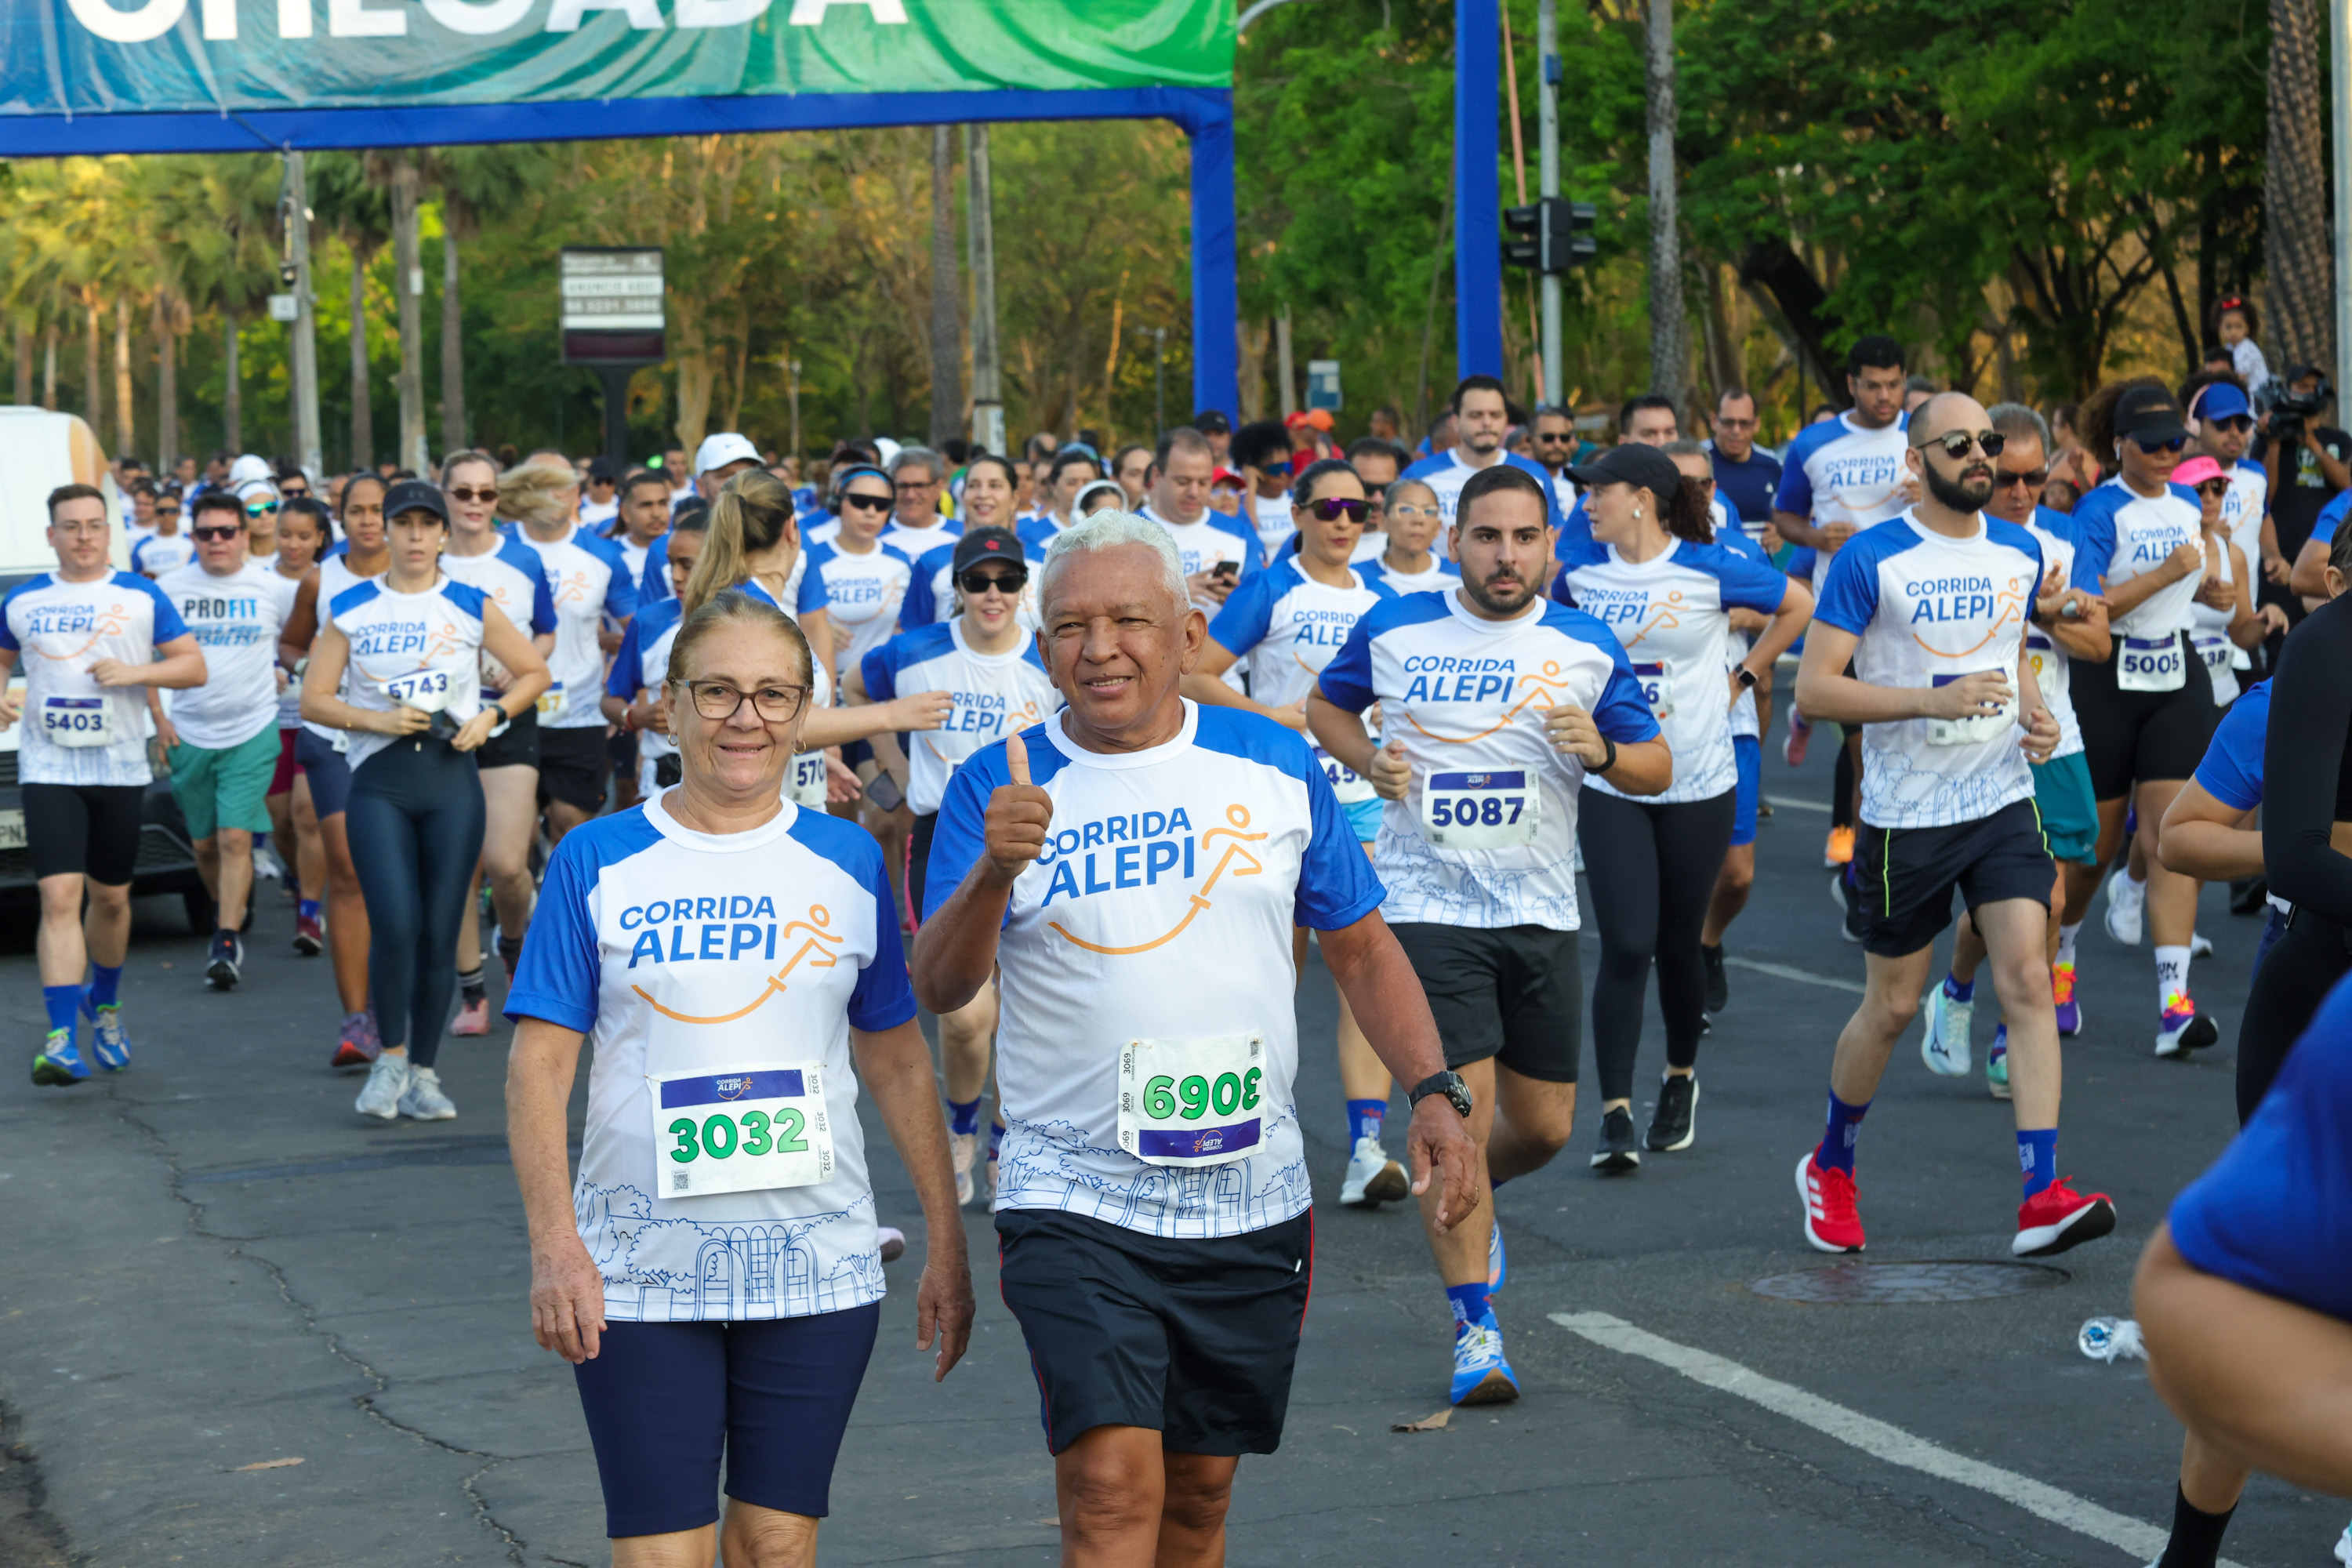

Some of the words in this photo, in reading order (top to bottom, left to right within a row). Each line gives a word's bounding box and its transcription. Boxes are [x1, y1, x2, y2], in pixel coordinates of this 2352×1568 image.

[1825, 455, 1896, 473] CORRIDA
[1829, 468, 1896, 489] ALEPI
[2131, 525, 2186, 542] CORRIDA
[830, 589, 882, 603] ALEPI
[1906, 577, 1992, 597] CORRIDA
[26, 604, 95, 619] CORRIDA
[183, 599, 257, 618] PROFIT
[1911, 595, 1994, 625] ALEPI
[28, 616, 95, 637] ALEPI
[358, 622, 426, 638] CORRIDA
[355, 635, 426, 655] ALEPI
[1403, 655, 1515, 673] CORRIDA
[2125, 653, 2180, 674] 5005
[389, 673, 448, 700] 5743
[1403, 675, 1515, 703] ALEPI
[951, 691, 1007, 711] RRIDA
[45, 713, 103, 731] 5403
[943, 710, 1004, 736] LEPI
[1432, 797, 1525, 827] 5087
[1035, 807, 1192, 866] CORRIDA
[1041, 835, 1196, 907] ALEPI
[619, 896, 777, 931] CORRIDA
[628, 924, 778, 970] ALEPI
[1123, 1052, 1131, 1074] 3069
[717, 1083, 742, 1092] ALEPI
[811, 1073, 820, 1094] 3032
[1122, 1092, 1131, 1113] 3069
[817, 1111, 826, 1132] 3032
[668, 1107, 809, 1163] 3032
[1203, 1138, 1223, 1147] ALEPI
[822, 1149, 831, 1171] 3032
